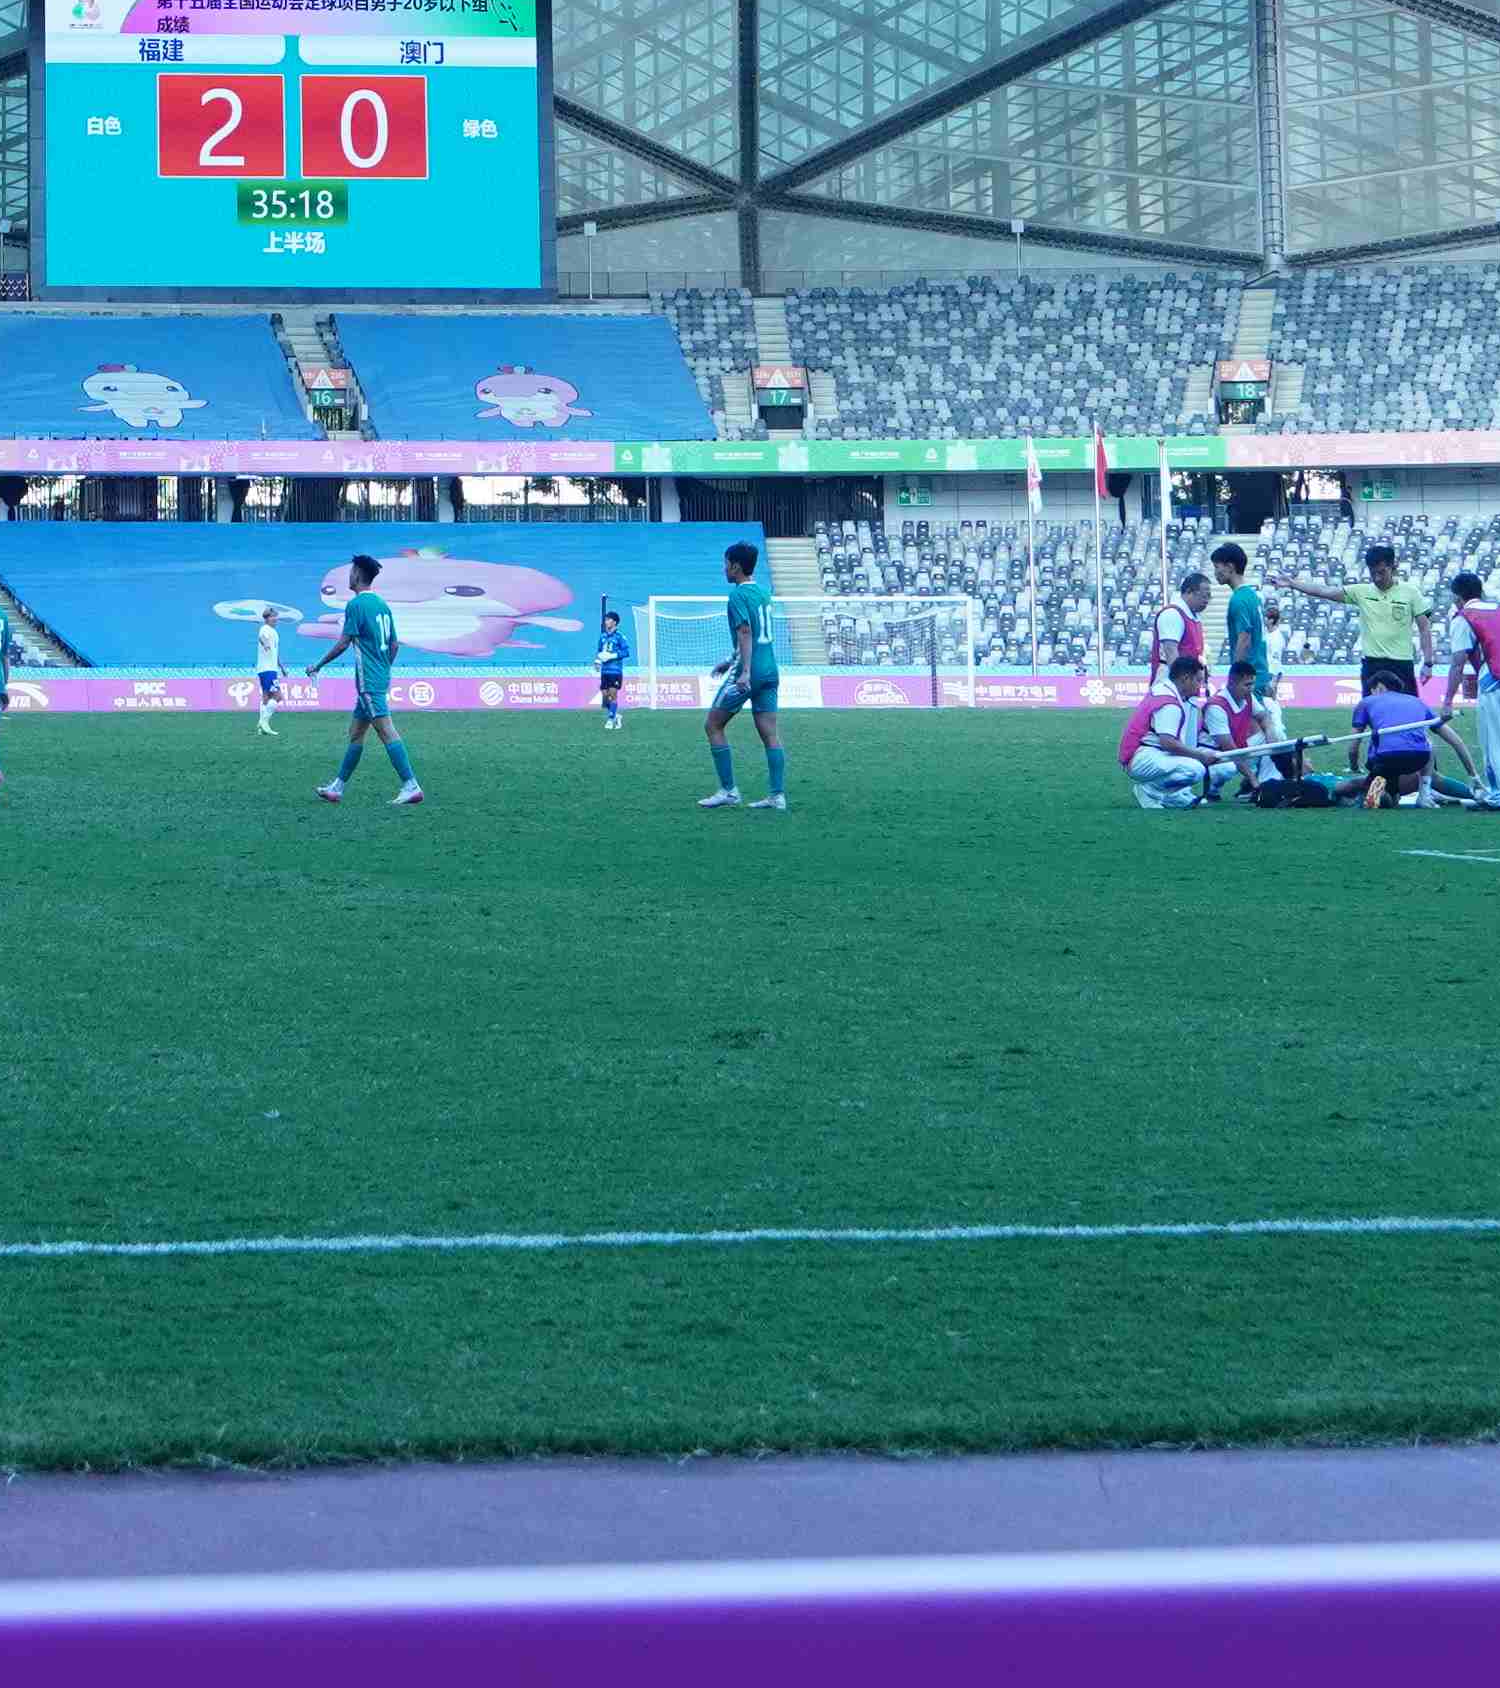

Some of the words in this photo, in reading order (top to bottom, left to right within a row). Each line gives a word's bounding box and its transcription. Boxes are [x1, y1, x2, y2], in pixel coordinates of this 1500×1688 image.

[156, 16, 190, 33] 成绩
[139, 38, 184, 62] 福建
[400, 41, 444, 64] 澳门
[87, 116, 122, 136] 白色
[199, 88, 246, 167] 2
[340, 89, 389, 169] 0
[462, 119, 498, 138] 绿色
[252, 190, 334, 219] 35:18
[263, 231, 326, 254] 上半场
[314, 390, 331, 405] 16
[770, 390, 788, 405] 17
[1236, 383, 1256, 399] 18
[134, 682, 166, 695] PICC
